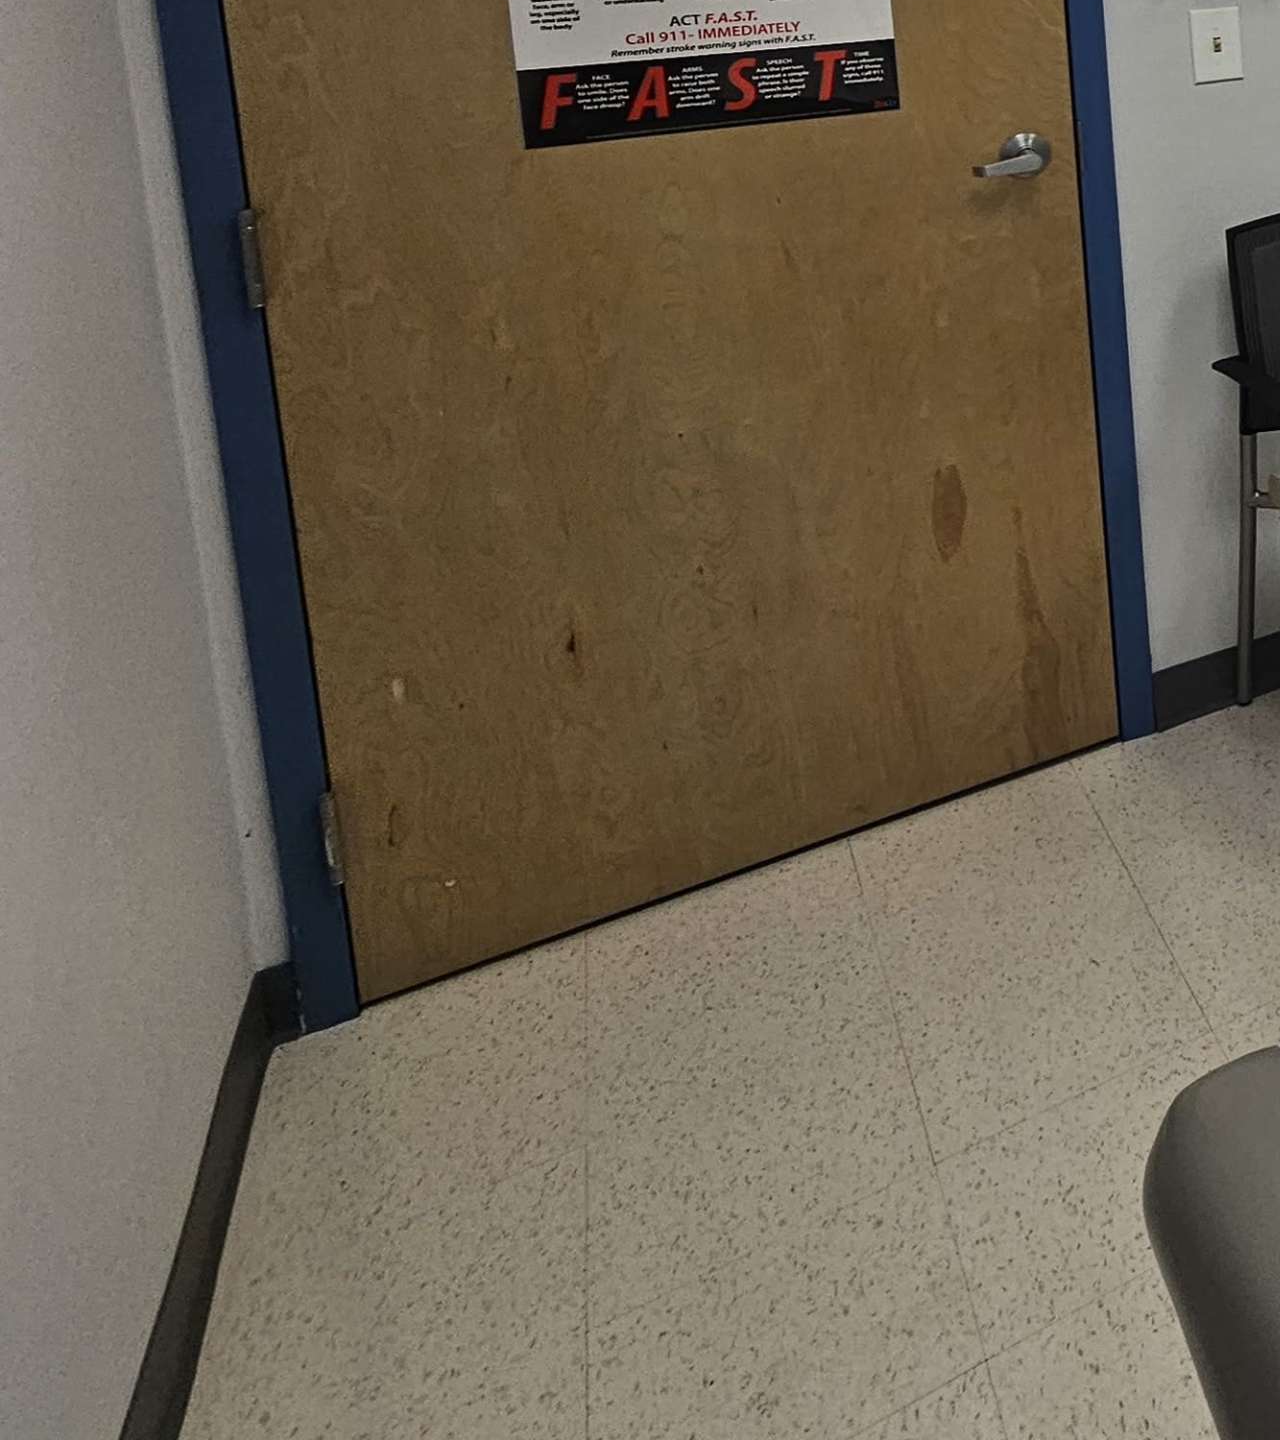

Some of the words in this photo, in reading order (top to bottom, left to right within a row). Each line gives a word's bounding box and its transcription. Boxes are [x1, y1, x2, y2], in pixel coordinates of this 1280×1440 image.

[670, 14, 700, 27] ACT
[704, 10, 758, 25] F.A.S.T.
[625, 31, 655, 45] Call
[698, 20, 800, 40] IMMEDIATELY
[611, 47, 664, 57] Remember
[666, 44, 696, 53] stroke
[697, 41, 737, 50] warning
[738, 40, 762, 48] signs
[785, 34, 816, 43] F.A.S.T.
[540, 73, 577, 130] F
[627, 66, 670, 121] A
[725, 57, 757, 111] S
[813, 49, 847, 101] T
